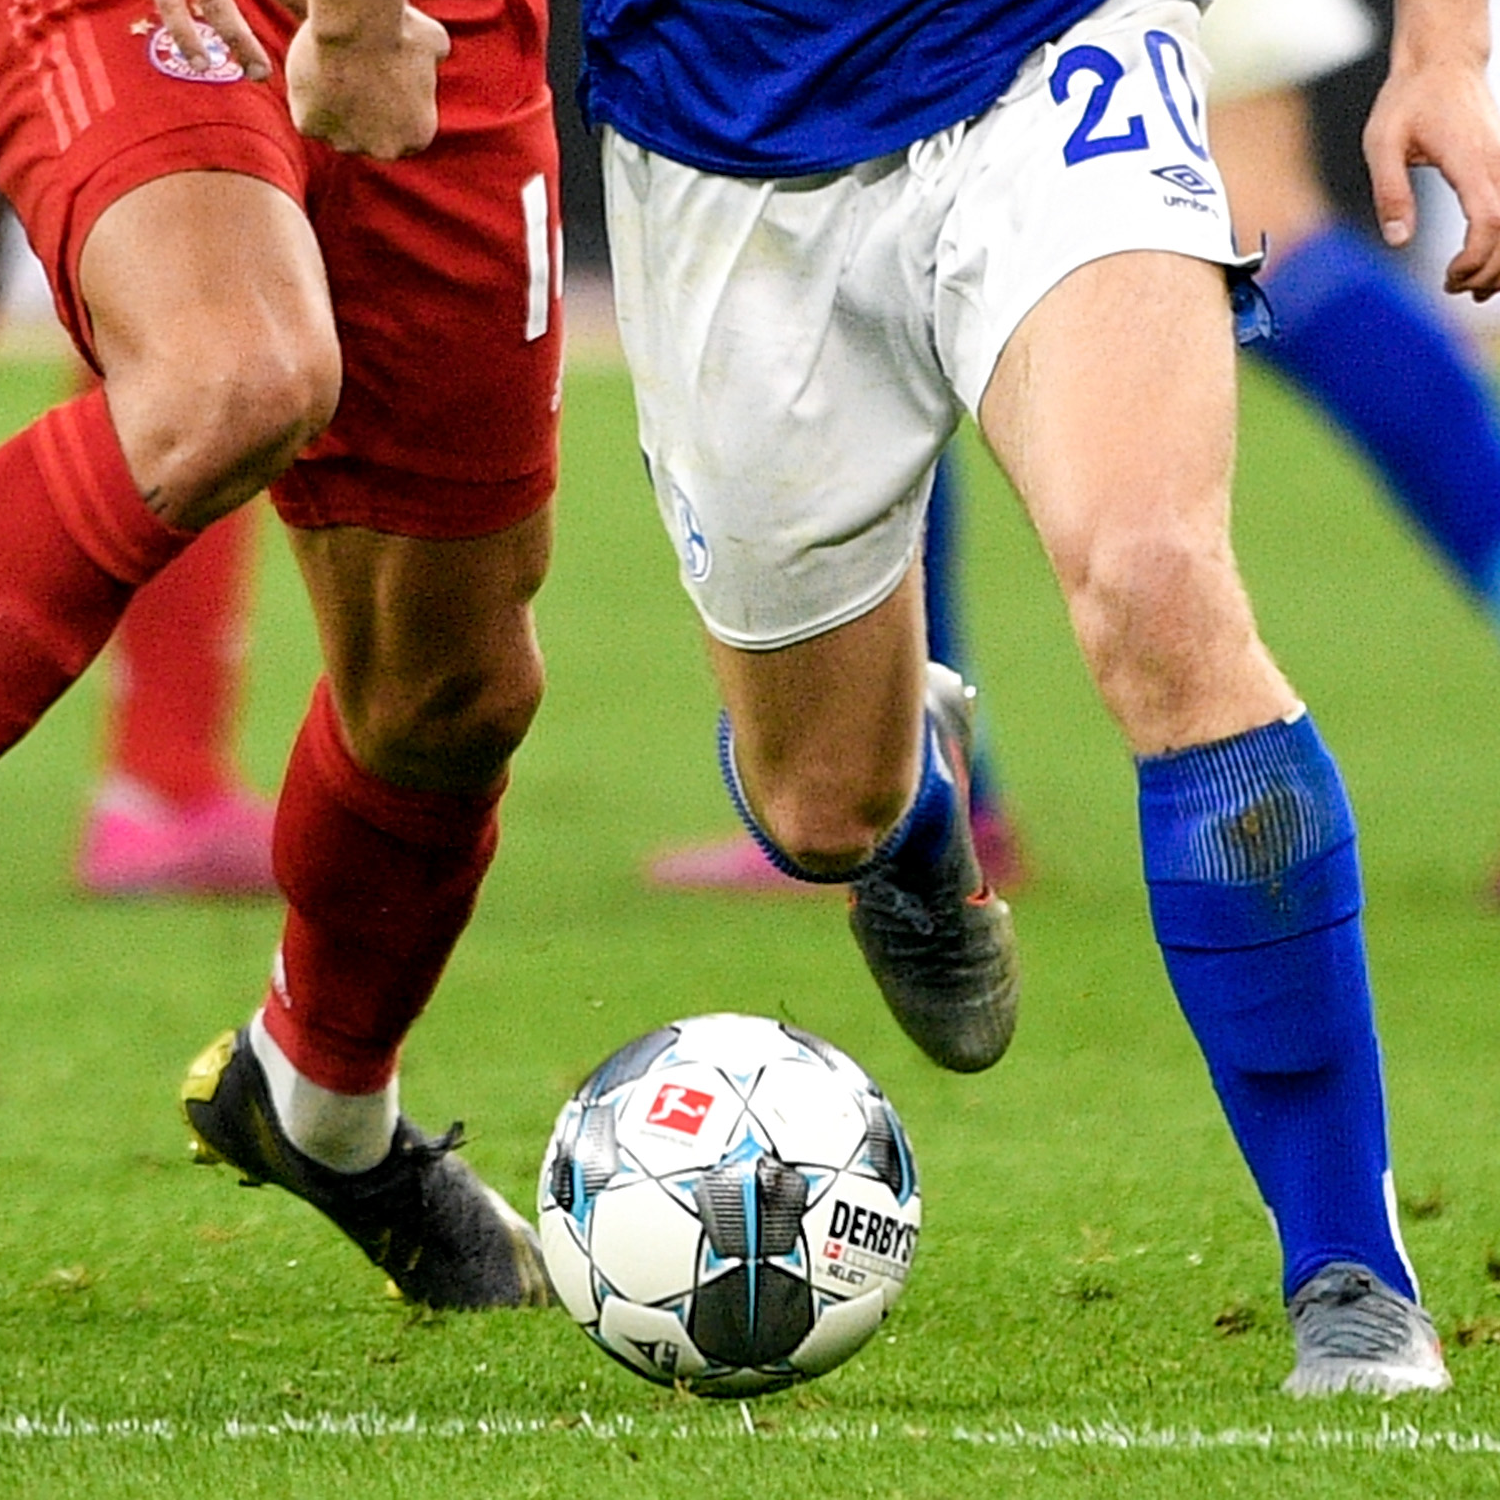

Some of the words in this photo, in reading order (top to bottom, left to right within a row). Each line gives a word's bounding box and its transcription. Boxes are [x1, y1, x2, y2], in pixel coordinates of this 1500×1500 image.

[1048, 29, 1209, 168] 20
[521, 172, 564, 343] 1
[1163, 195, 1219, 220] umbr
